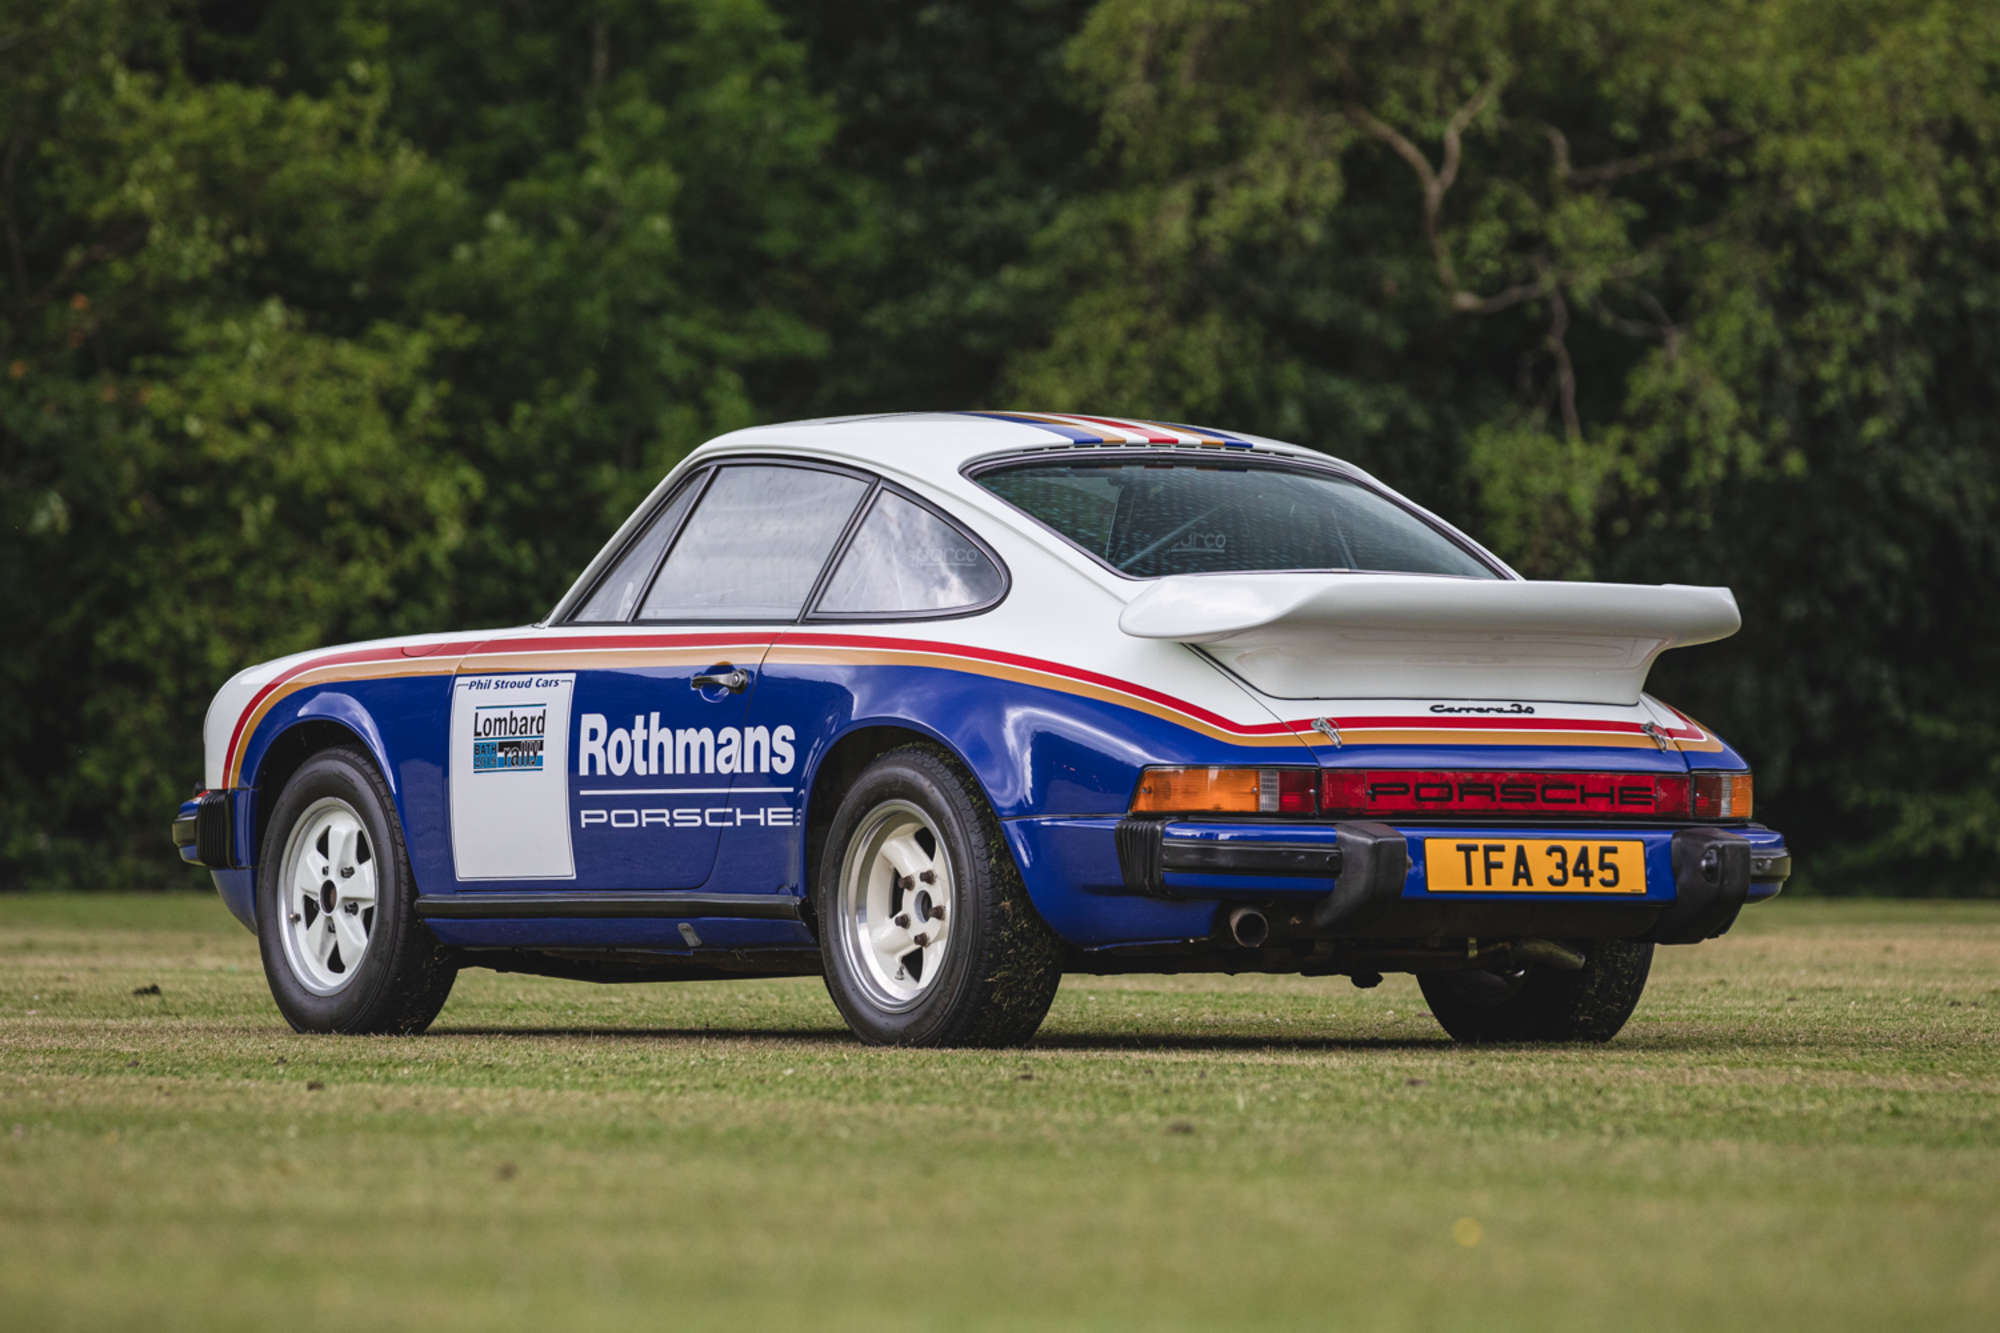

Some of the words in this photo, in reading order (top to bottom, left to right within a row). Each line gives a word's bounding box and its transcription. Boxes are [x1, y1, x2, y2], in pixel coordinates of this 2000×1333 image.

[468, 680, 492, 690] Phil
[494, 678, 533, 689] Stroud
[536, 678, 559, 688] Cars
[1429, 704, 1505, 714] Carrera
[474, 708, 546, 737] Lombard
[503, 741, 539, 767] rally
[579, 712, 796, 777] Rothmans
[1370, 783, 1652, 806] PORSCHE
[580, 807, 794, 828] PORSCHE
[1456, 844, 1533, 886] TFA
[1546, 844, 1620, 888] 345
